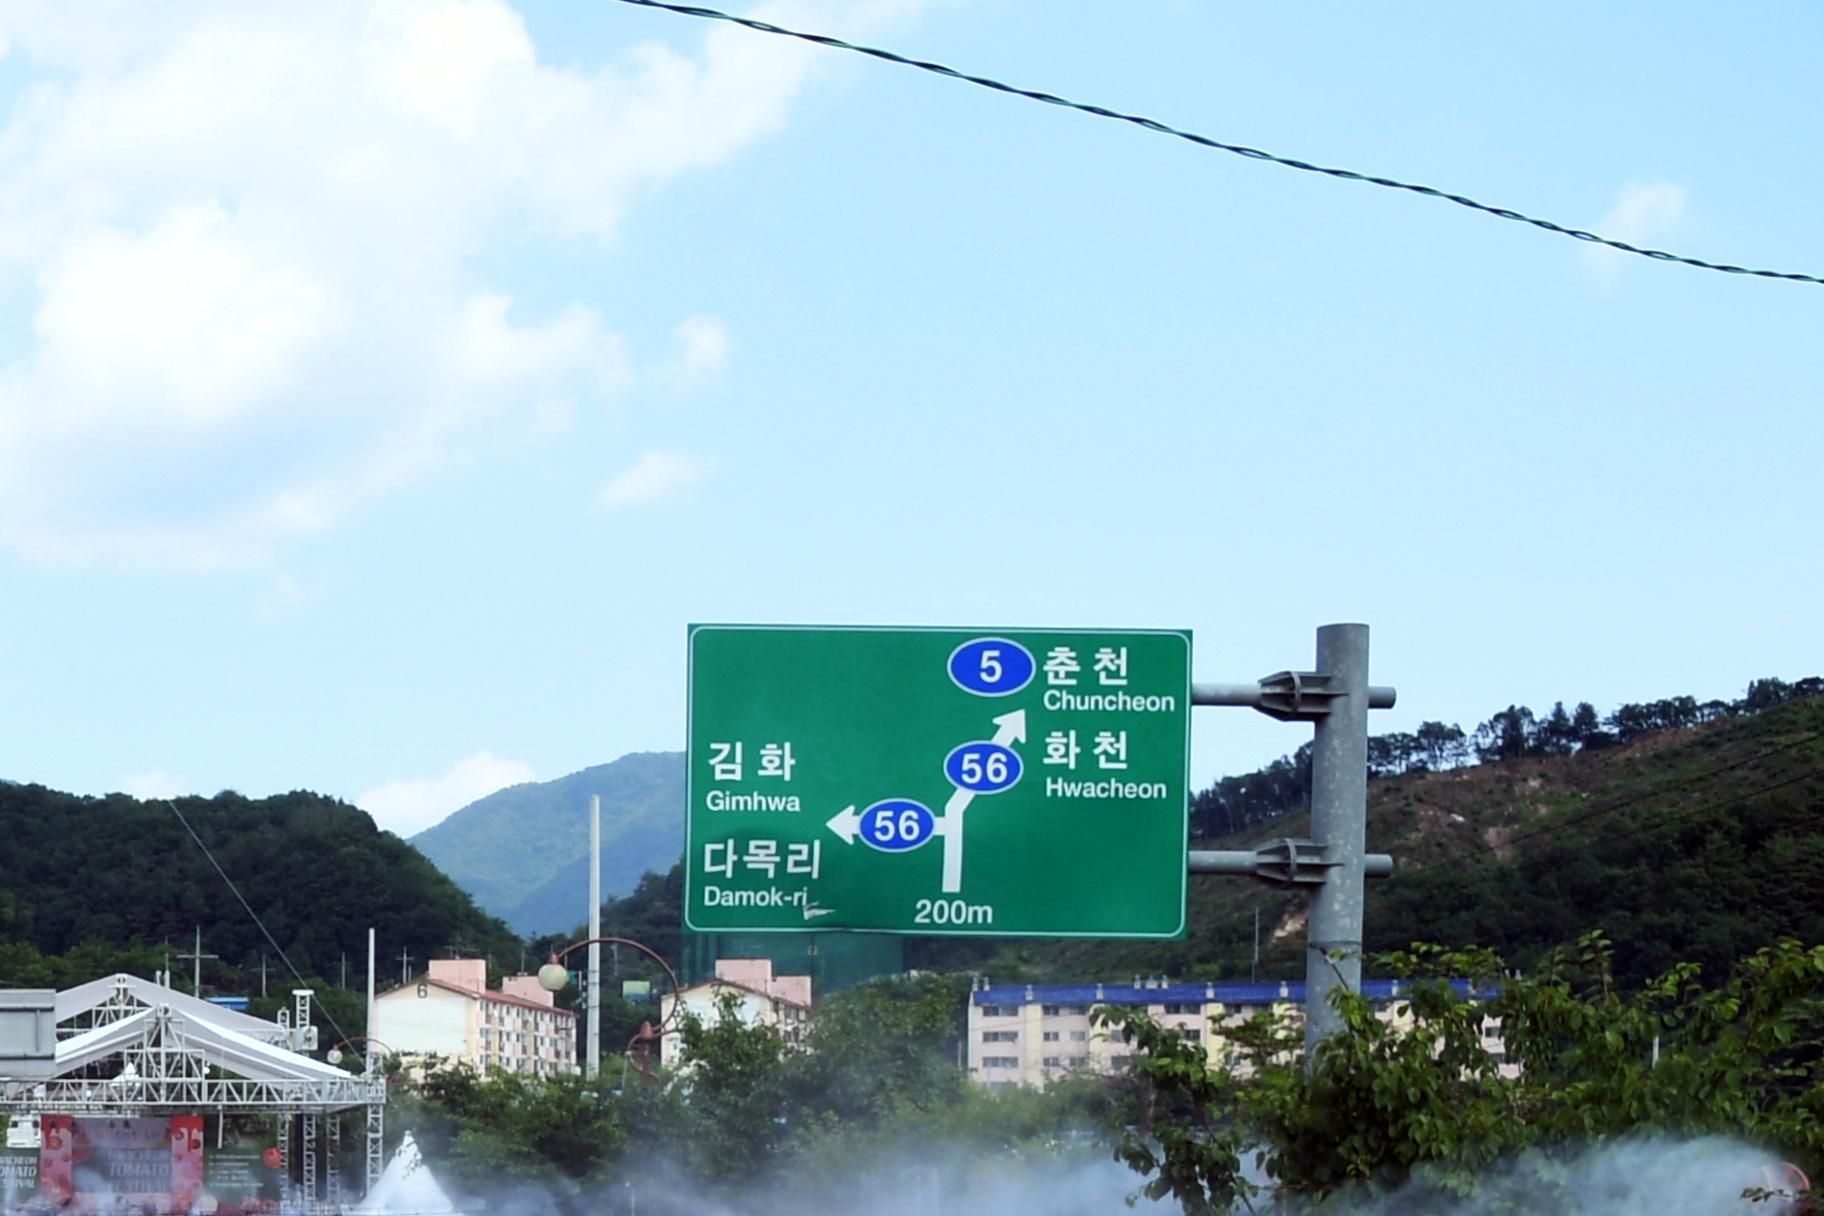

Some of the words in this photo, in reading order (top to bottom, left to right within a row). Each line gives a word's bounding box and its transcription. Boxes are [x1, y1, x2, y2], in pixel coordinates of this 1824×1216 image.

[979, 650, 1003, 683] 5
[1043, 689, 1175, 712] Chuncheon
[961, 752, 1008, 784] 56
[1046, 776, 1167, 799] Hwacheon
[705, 790, 801, 812] Gimhwa
[874, 810, 920, 842] 56
[703, 838, 820, 879] 다목리
[703, 886, 808, 907] Damok-ri
[914, 899, 993, 924] 200m
[417, 983, 428, 999] 6
